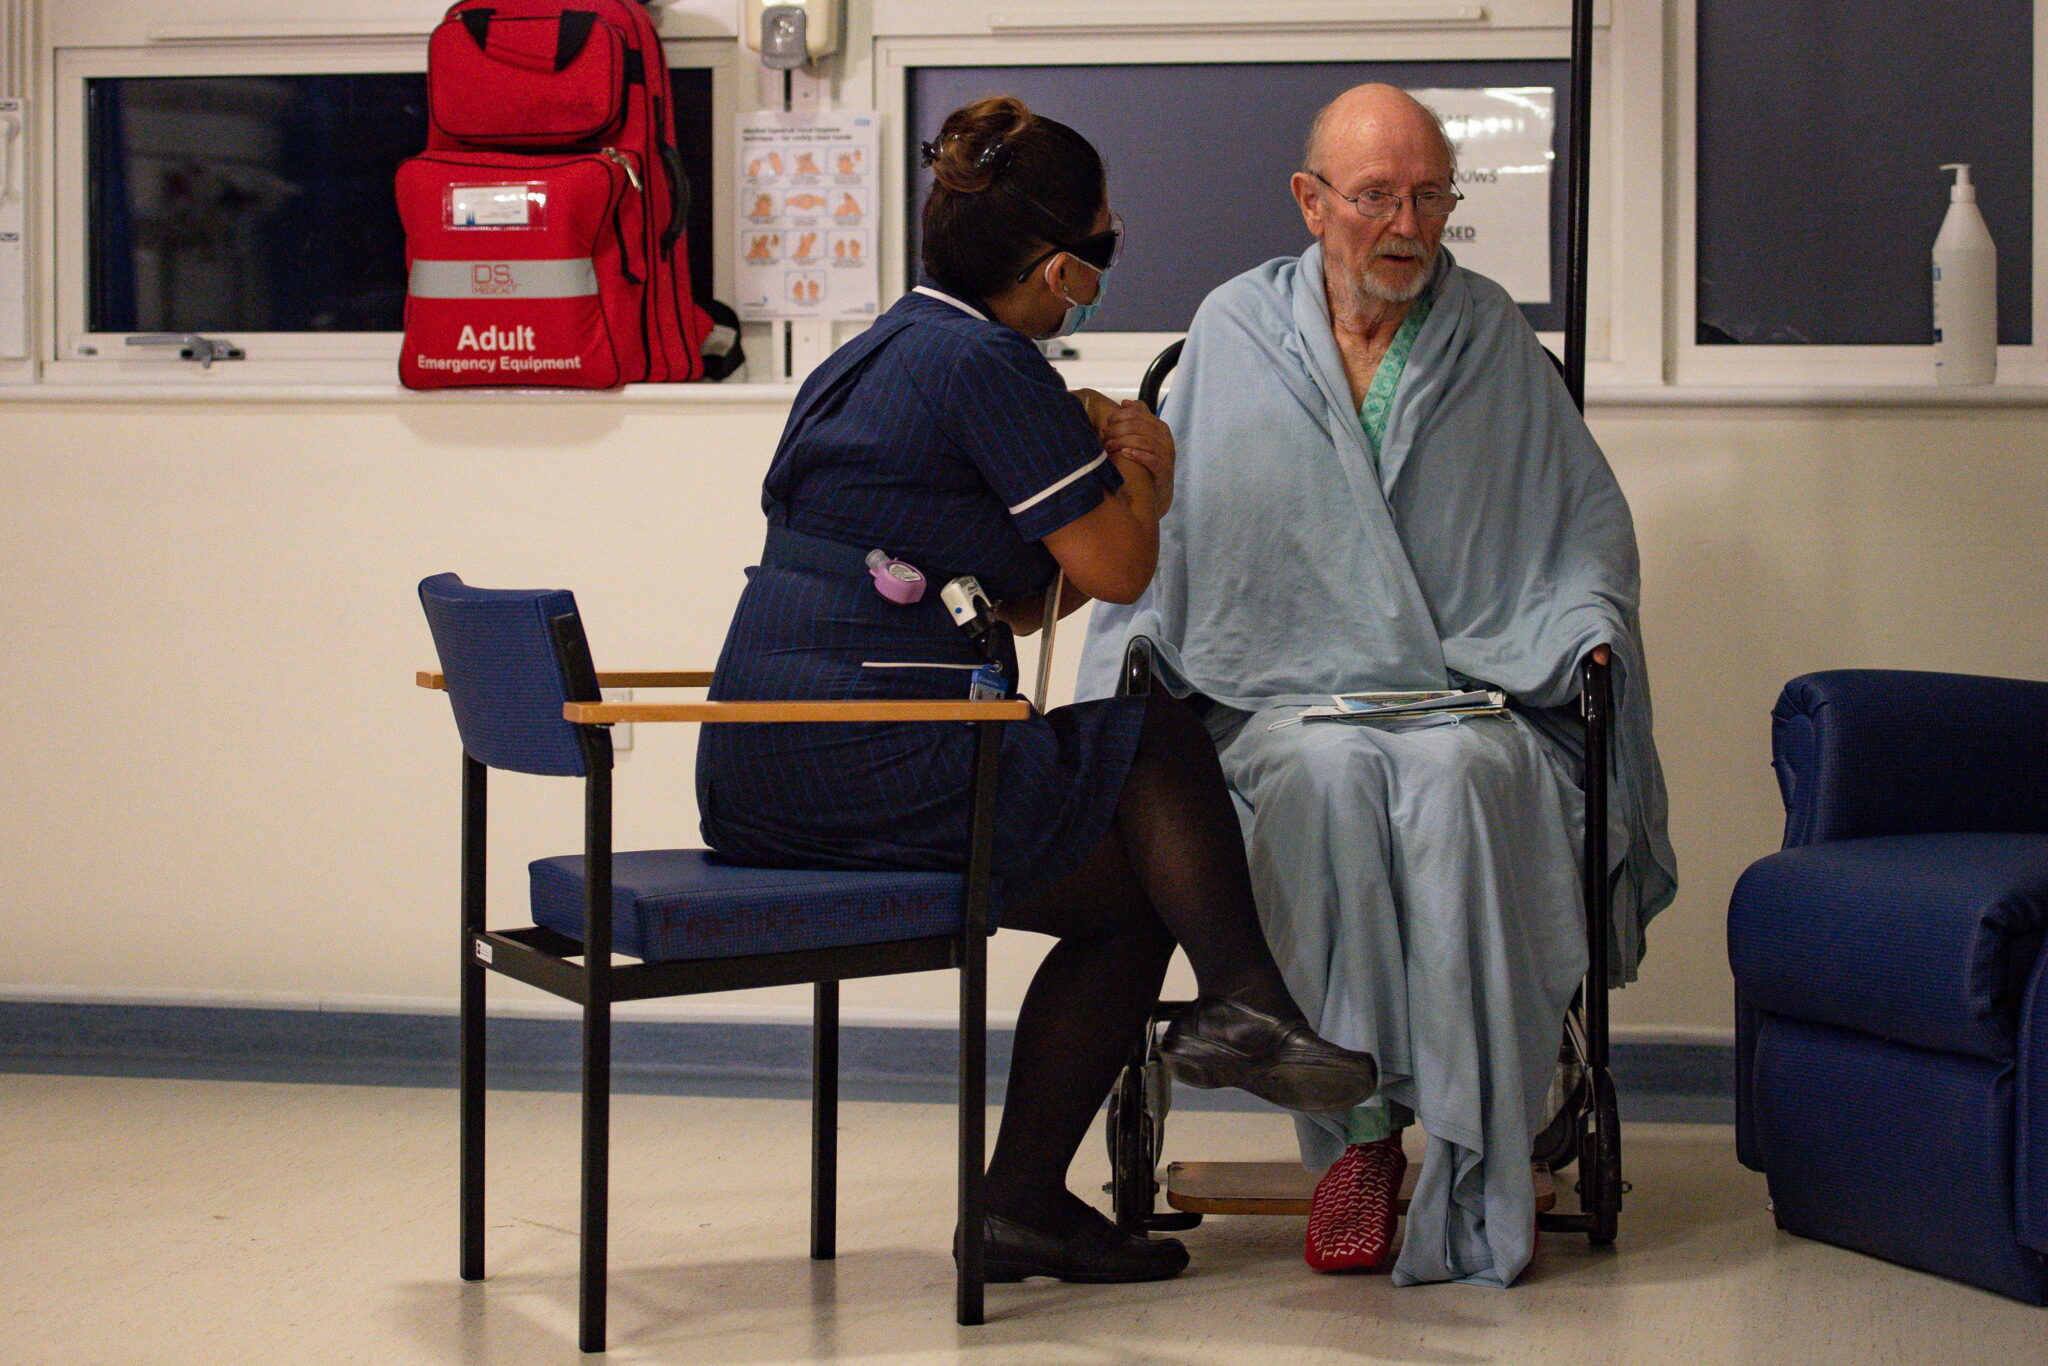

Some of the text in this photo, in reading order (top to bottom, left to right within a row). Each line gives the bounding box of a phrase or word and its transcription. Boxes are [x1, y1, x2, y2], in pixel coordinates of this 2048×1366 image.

[1442, 226, 1476, 239] SED
[474, 264, 511, 285] DS
[457, 324, 536, 351] Adult
[417, 354, 581, 373] Emergency Equipment
